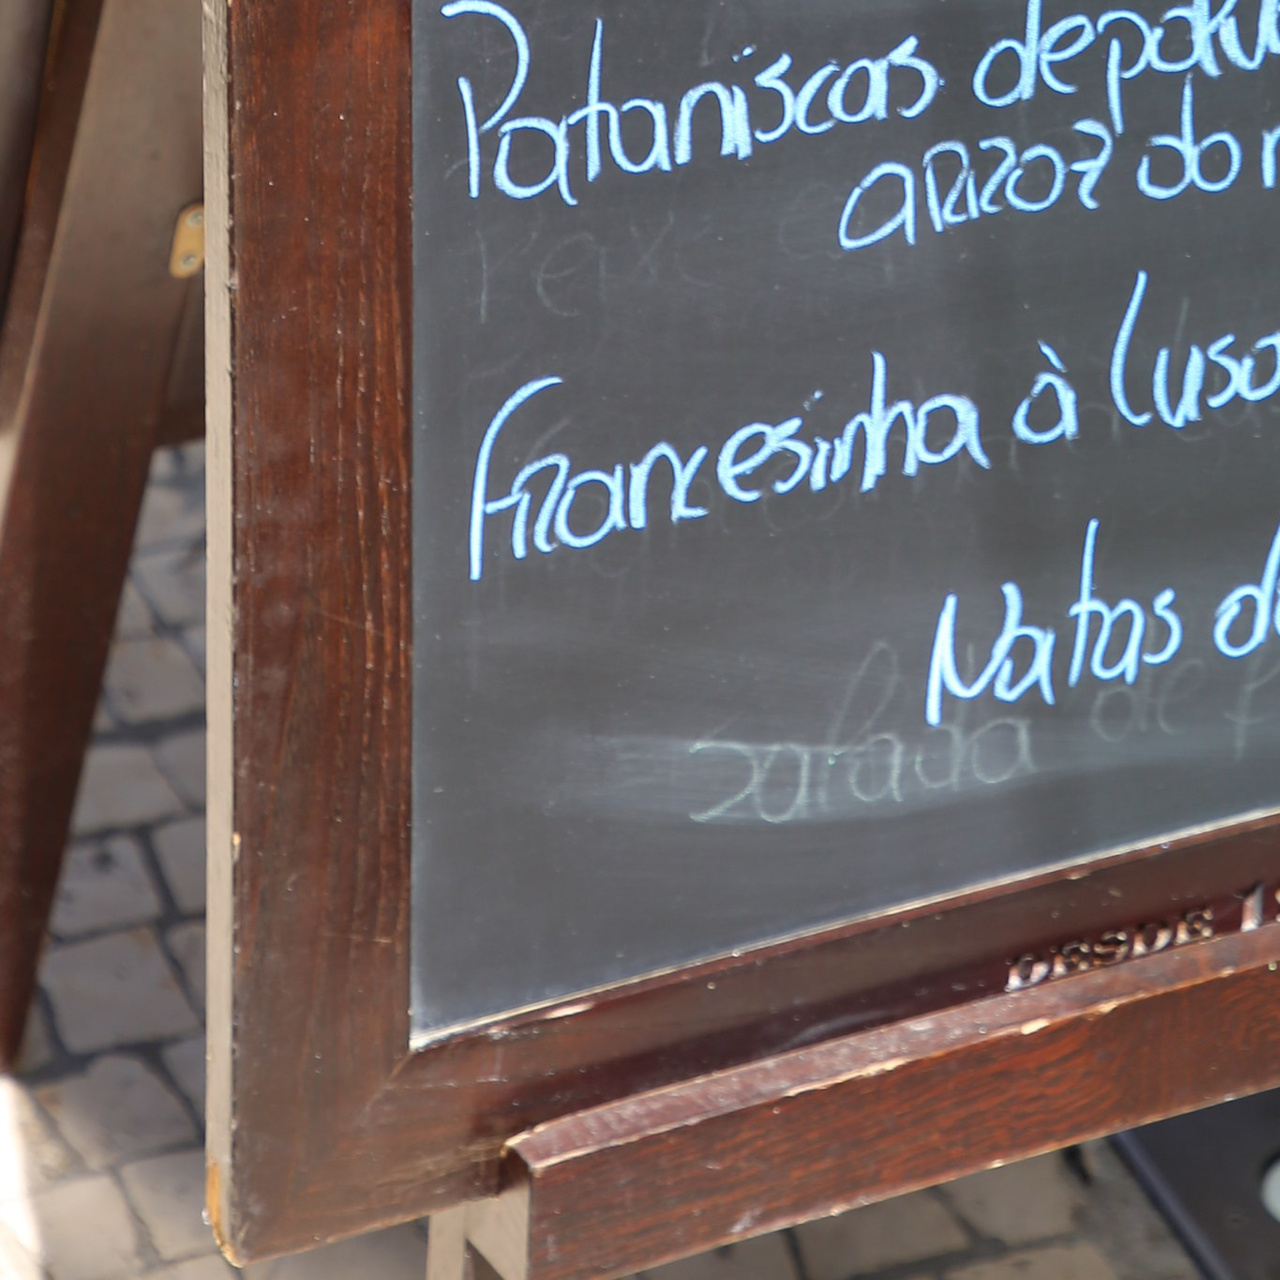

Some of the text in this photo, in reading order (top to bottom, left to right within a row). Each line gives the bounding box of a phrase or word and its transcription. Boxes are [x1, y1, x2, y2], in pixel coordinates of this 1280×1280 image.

[1136, 74, 1243, 200] do
[1012, 341, 1079, 444] à
[925, 518, 1184, 730] Natas
